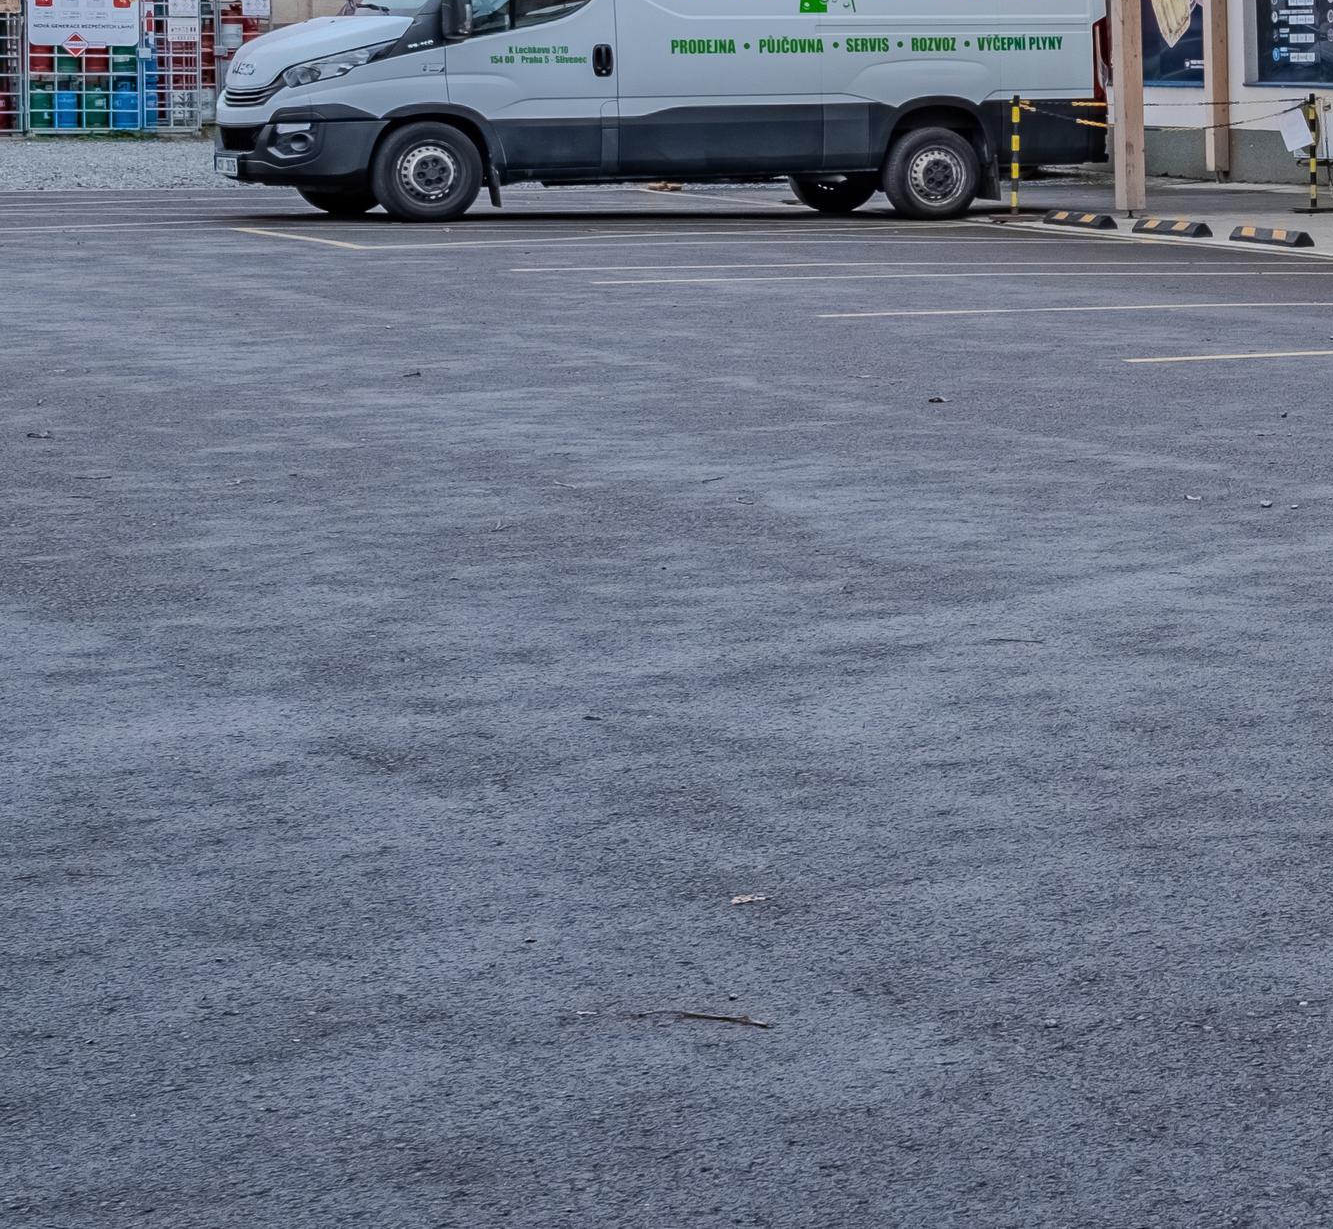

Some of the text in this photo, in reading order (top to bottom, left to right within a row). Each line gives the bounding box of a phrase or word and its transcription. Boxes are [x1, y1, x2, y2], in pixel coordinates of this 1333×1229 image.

[671, 35, 1063, 54] PRODEJNA PŮJČOVNA SERVIS ROZVOZ VÝČEPNÍ PLYNY
[508, 46, 513, 54] K
[490, 55, 503, 64] 154
[504, 55, 515, 64] 00
[521, 55, 543, 64] Praha
[544, 55, 549, 64] 5
